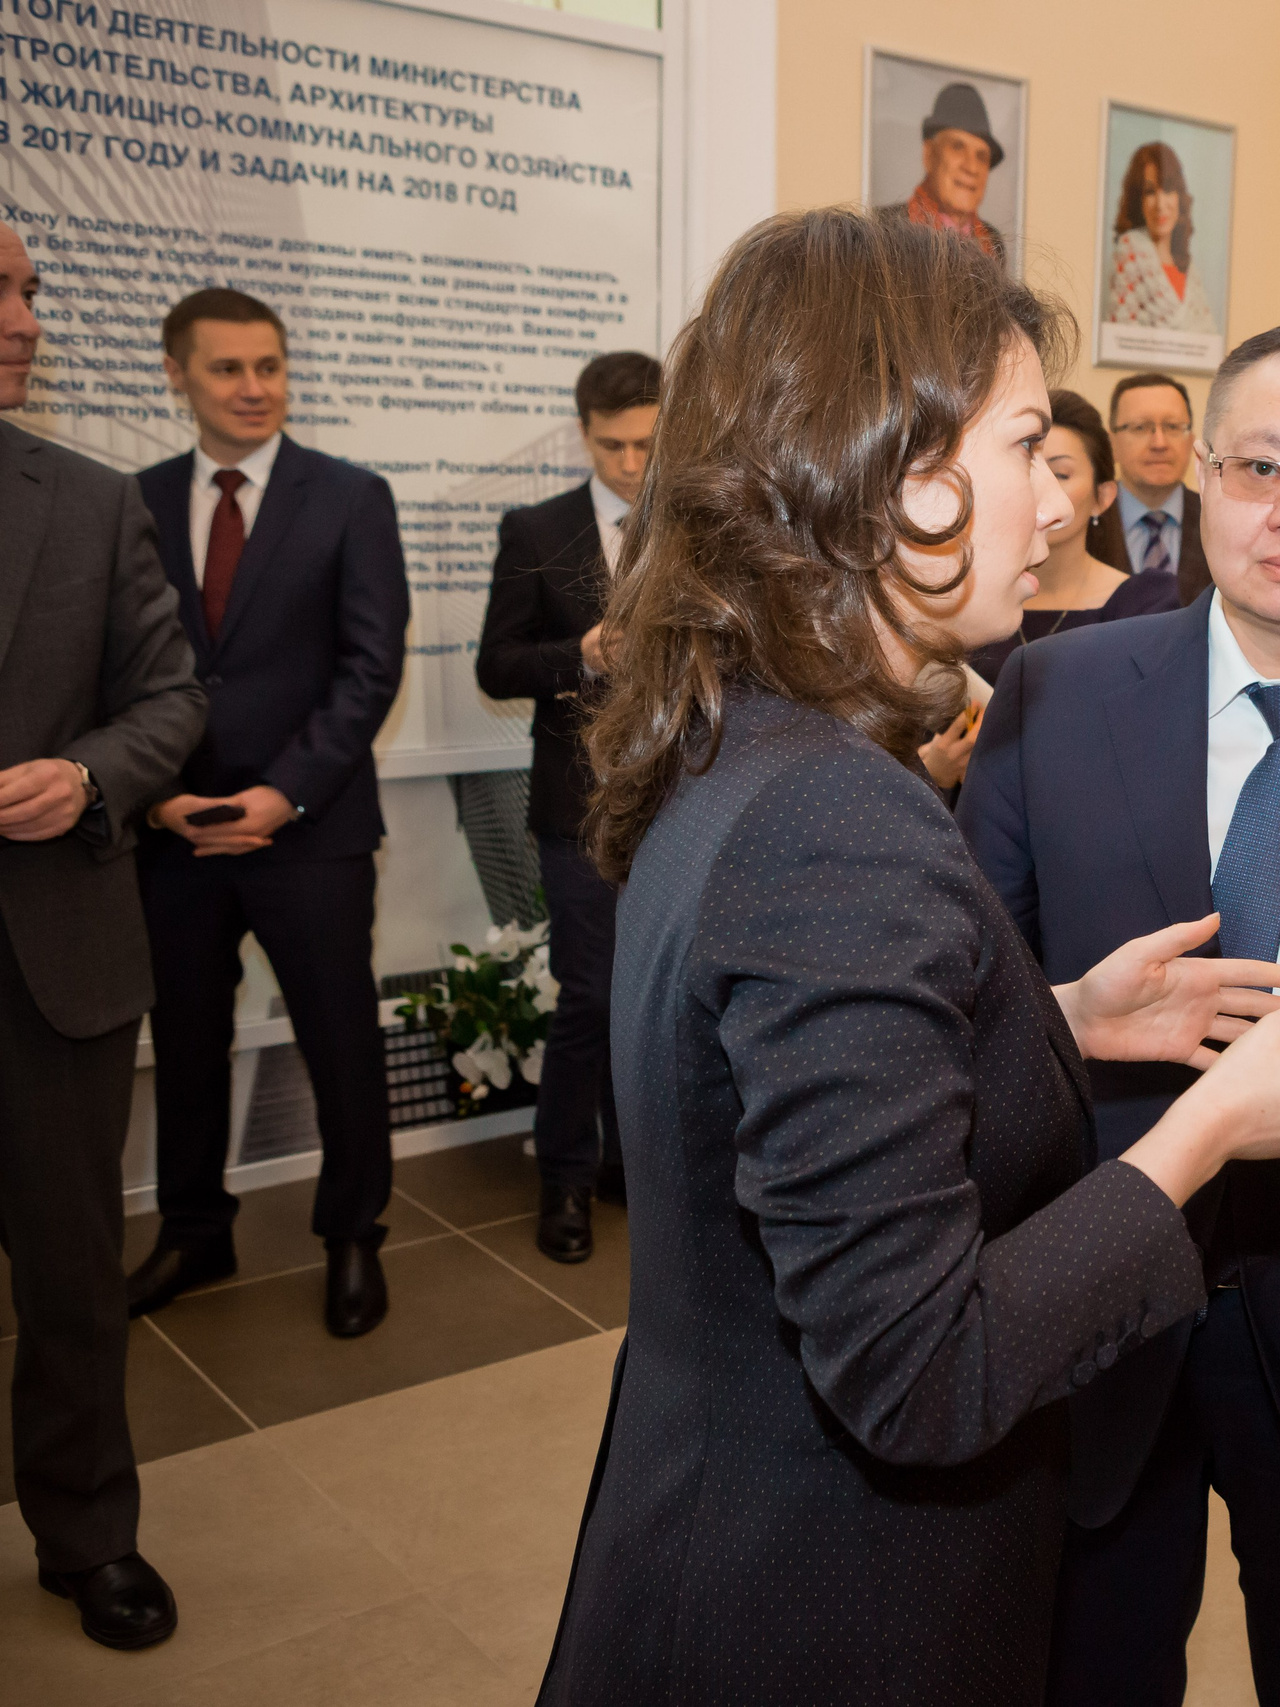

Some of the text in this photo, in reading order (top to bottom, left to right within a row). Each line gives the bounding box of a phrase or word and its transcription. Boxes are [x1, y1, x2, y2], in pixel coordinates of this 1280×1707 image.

[0, 0, 582, 111] ТОГИ ДЕЯТЕЛЬНОСТИ МИНИСТЕРСТВА
[0, 33, 495, 134] ТРОИТЕЛЬСТВА, АРХИТЕКТУРЫ
[20, 78, 633, 190] ЖИЛИЩНО-КОММУНАЛЬНОГО ХОЗЯЙСТВА
[22, 124, 93, 156] 2017
[104, 135, 190, 170] ГОДУ
[200, 149, 221, 174] И
[229, 152, 349, 188] ЗАДАЧИ
[357, 168, 396, 196] НА
[403, 175, 459, 205] 2018
[466, 182, 518, 215] ГОД
[0, 204, 60, 231] Хочу
[34, 259, 144, 281] ременное
